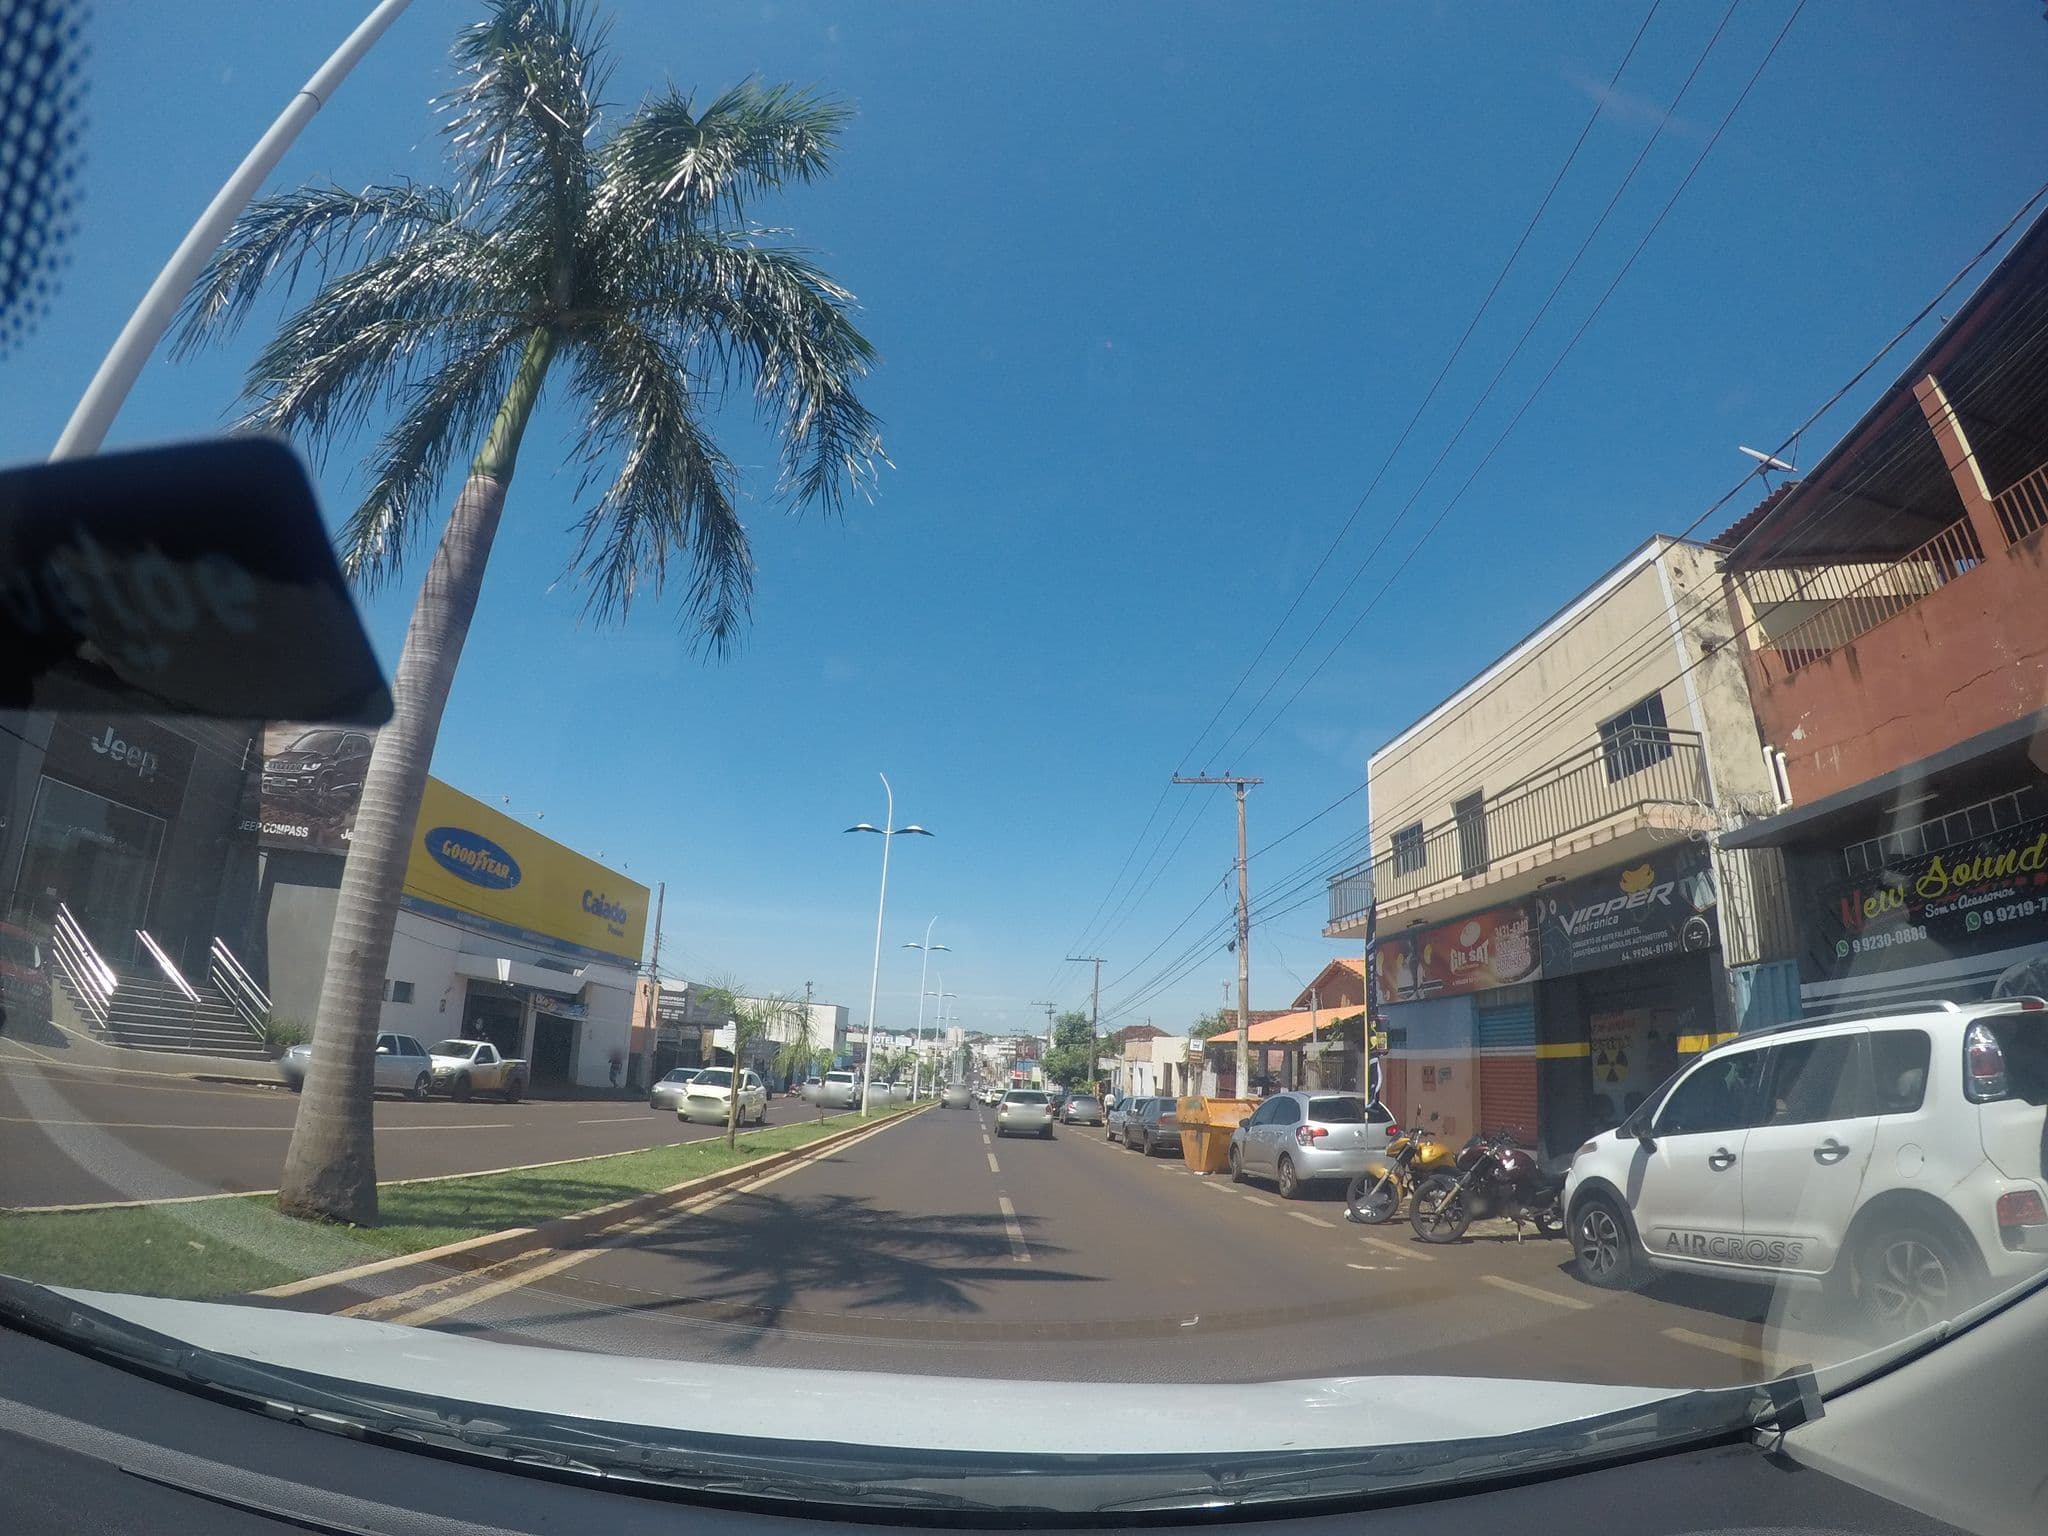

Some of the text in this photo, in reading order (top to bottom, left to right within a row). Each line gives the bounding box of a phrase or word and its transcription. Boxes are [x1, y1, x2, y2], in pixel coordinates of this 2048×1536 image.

[91, 726, 157, 777] Jeep
[239, 820, 309, 838] JEEP COMPASS
[441, 839, 511, 880] GOODYEAR
[1916, 832, 2048, 898] Sound
[582, 889, 627, 925] Caiado
[1559, 881, 1675, 936] VIPPER
[1996, 897, 2048, 922] 9219-7
[872, 1034, 896, 1045] OTEL
[1666, 1232, 1804, 1264] AIRCROSS
